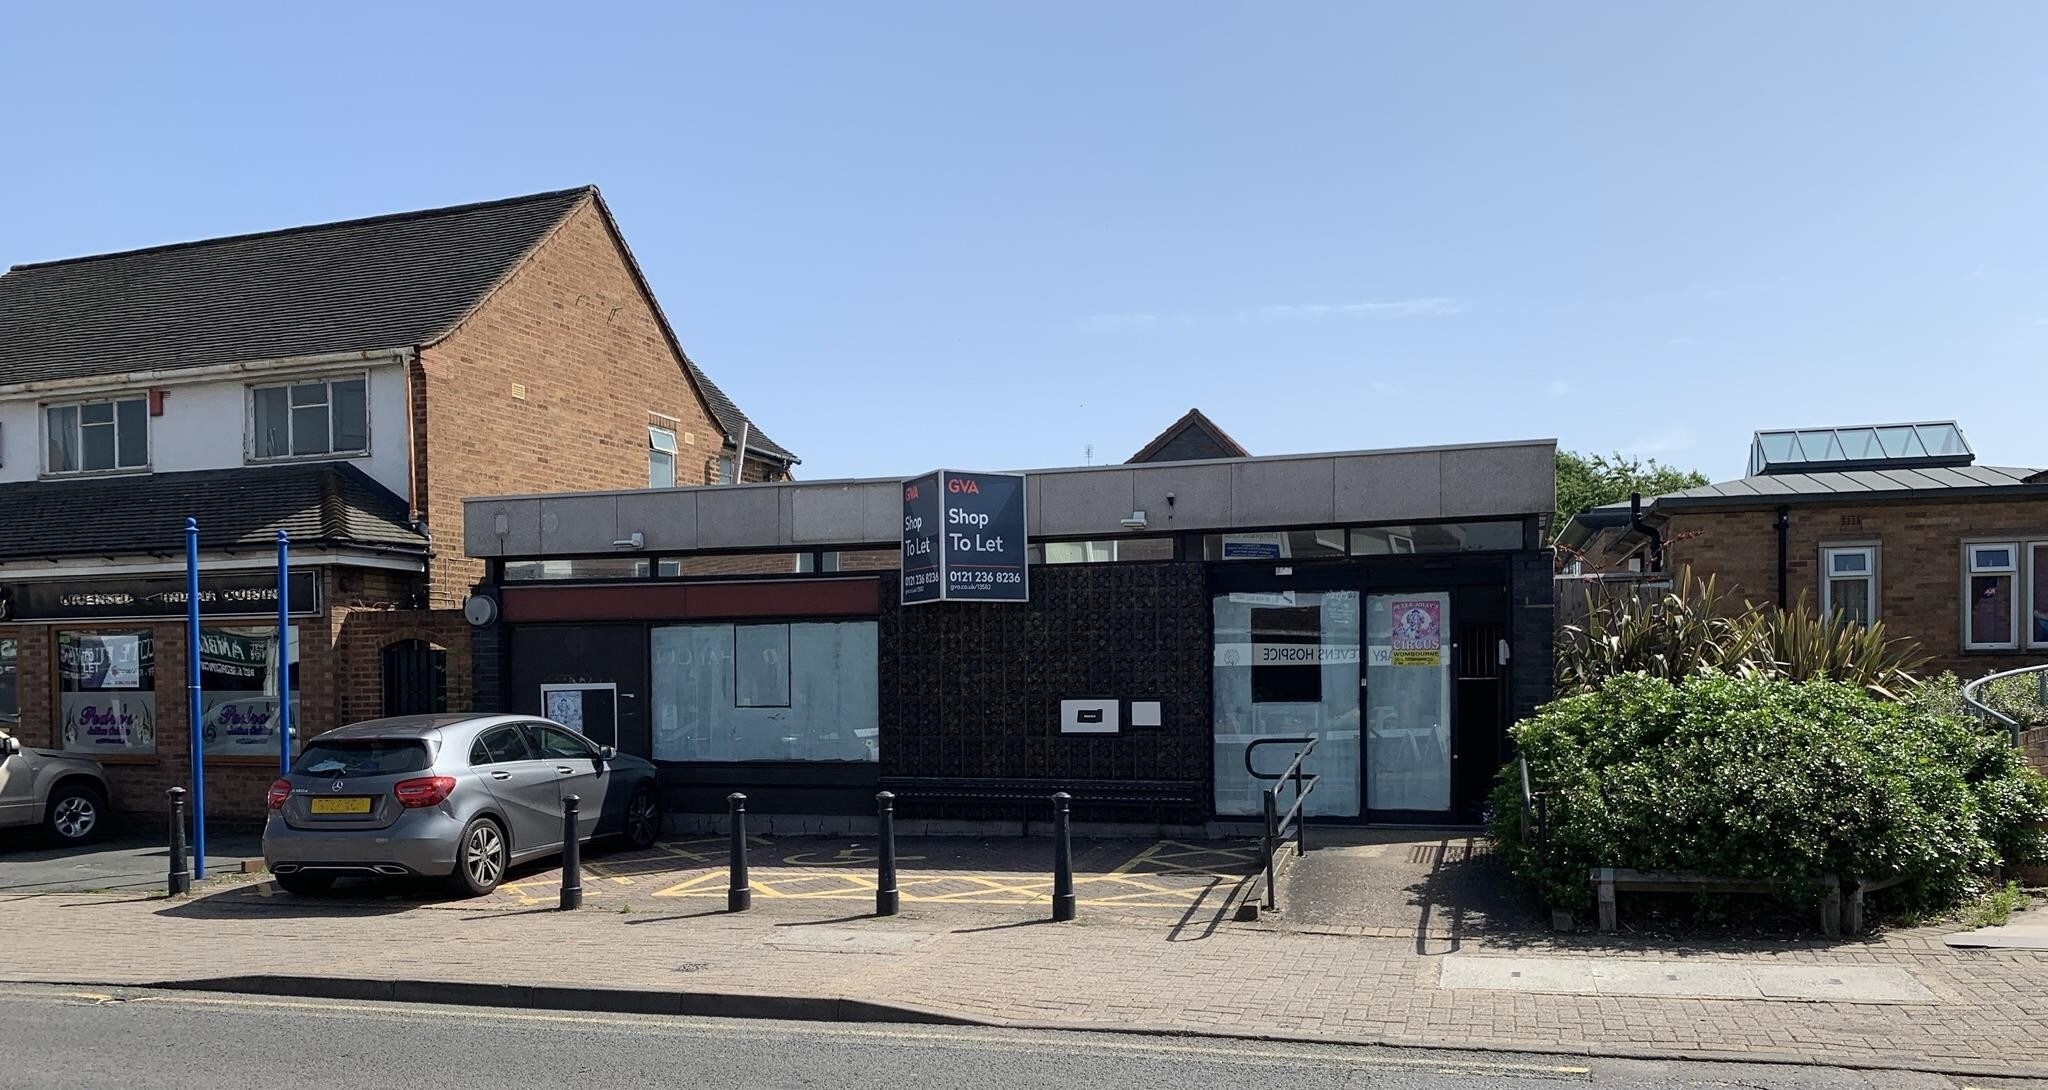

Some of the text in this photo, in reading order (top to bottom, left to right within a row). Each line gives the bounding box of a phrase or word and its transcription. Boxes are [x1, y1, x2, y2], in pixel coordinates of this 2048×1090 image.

[905, 486, 919, 501] GVA
[948, 479, 980, 494] GVA
[905, 515, 923, 532] Shop
[948, 508, 989, 529] Shop
[905, 537, 931, 557] To Let
[949, 533, 1004, 552] To Let
[905, 571, 939, 586] 0121 236 8236
[950, 571, 1021, 583] 0121 236 8236
[1393, 640, 1440, 650] CIRCUS
[82, 650, 95, 662] TO
[83, 663, 99, 673] LET
